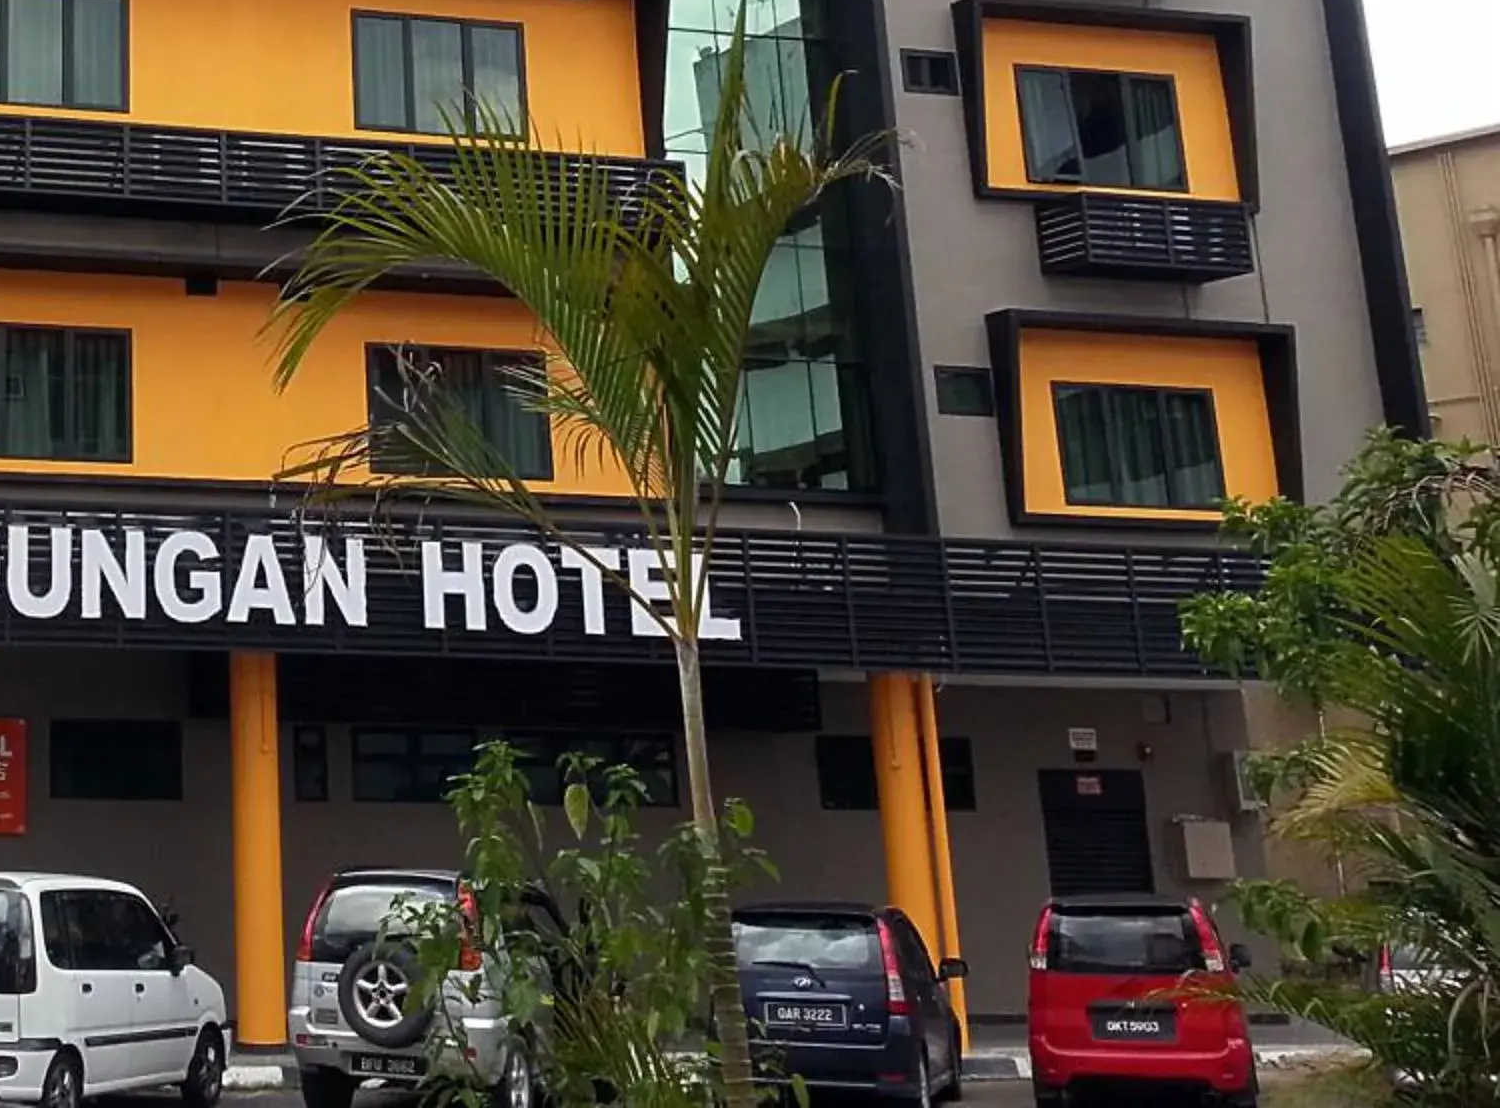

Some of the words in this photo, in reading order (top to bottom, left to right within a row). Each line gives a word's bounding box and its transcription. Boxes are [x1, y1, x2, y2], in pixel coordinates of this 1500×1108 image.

[421, 540, 742, 640] HOTEL
[777, 1007, 801, 1020] QAR
[803, 1008, 833, 1021] 3222
